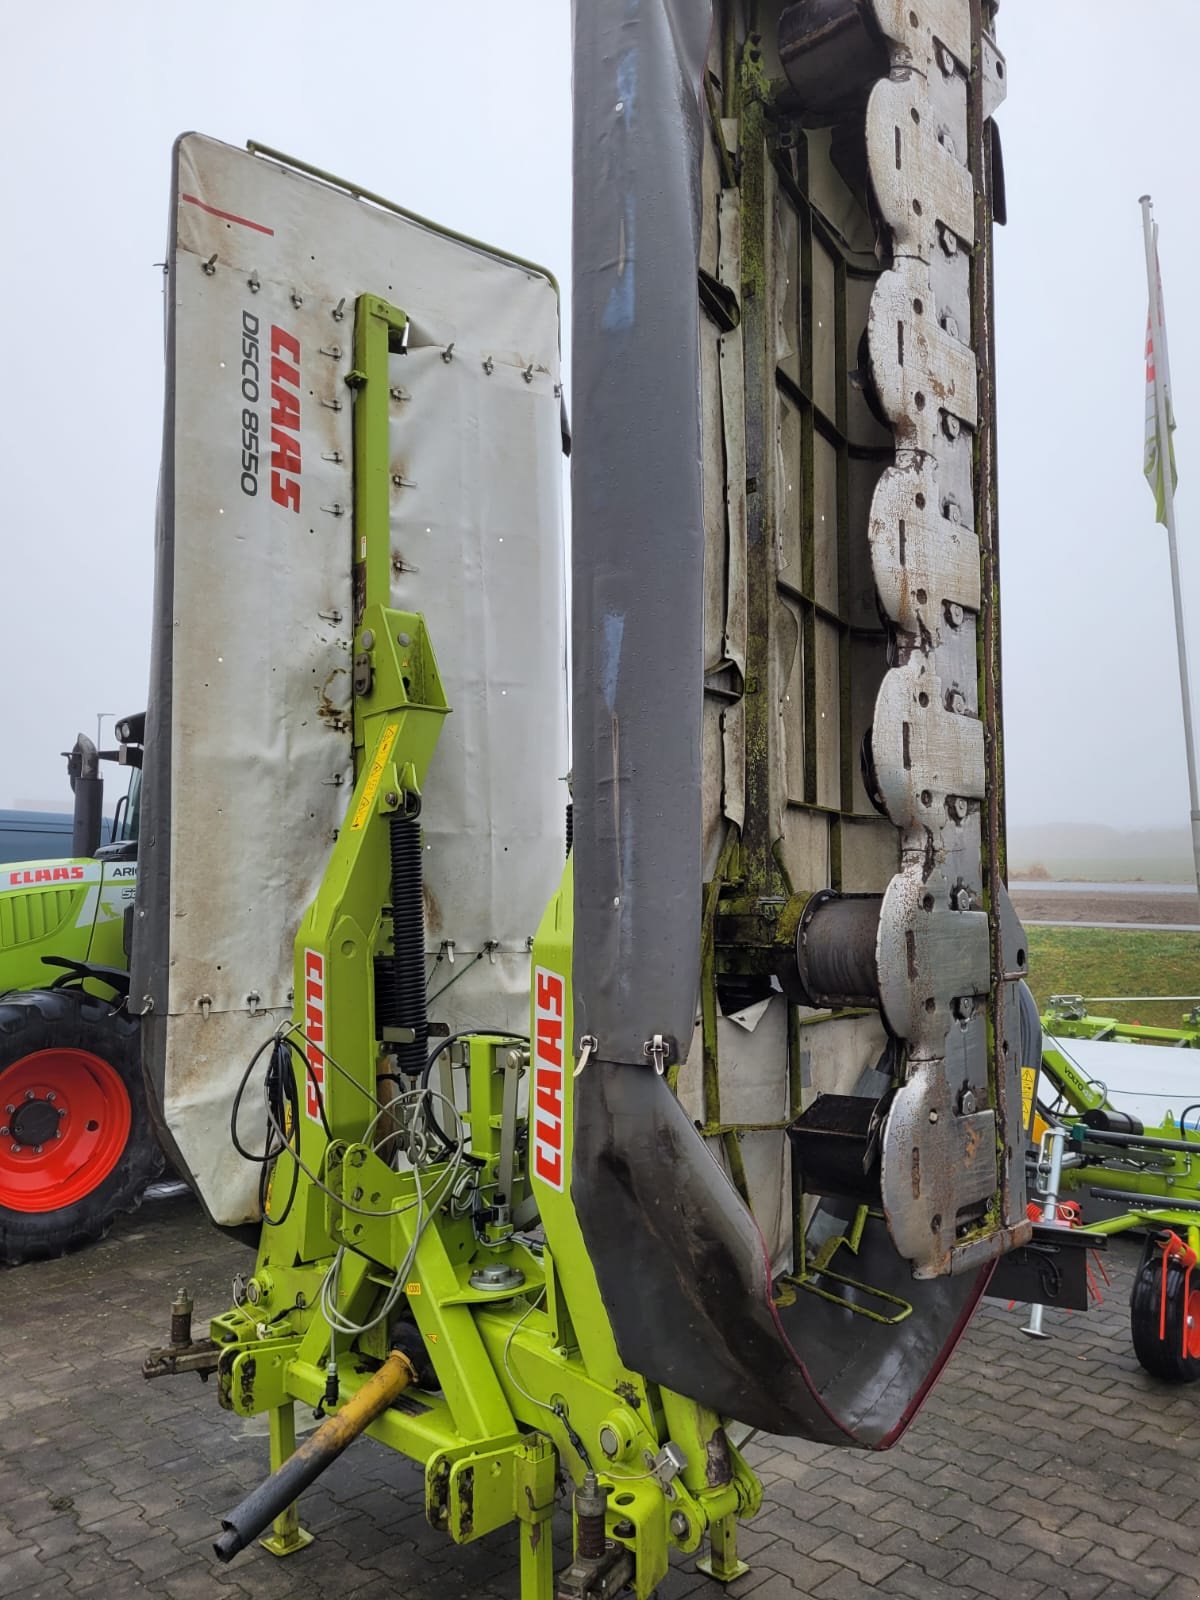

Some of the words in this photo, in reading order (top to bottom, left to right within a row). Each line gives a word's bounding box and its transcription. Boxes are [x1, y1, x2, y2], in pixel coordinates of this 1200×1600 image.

[241, 310, 259, 403] DISCO
[240, 408, 259, 497] 8550
[271, 324, 301, 514] CLAAS
[10, 867, 84, 885] CLAAS
[306, 951, 324, 1119] CLAAS
[536, 973, 563, 1186] CLAAS
[1064, 1066, 1085, 1091] VOLTO
